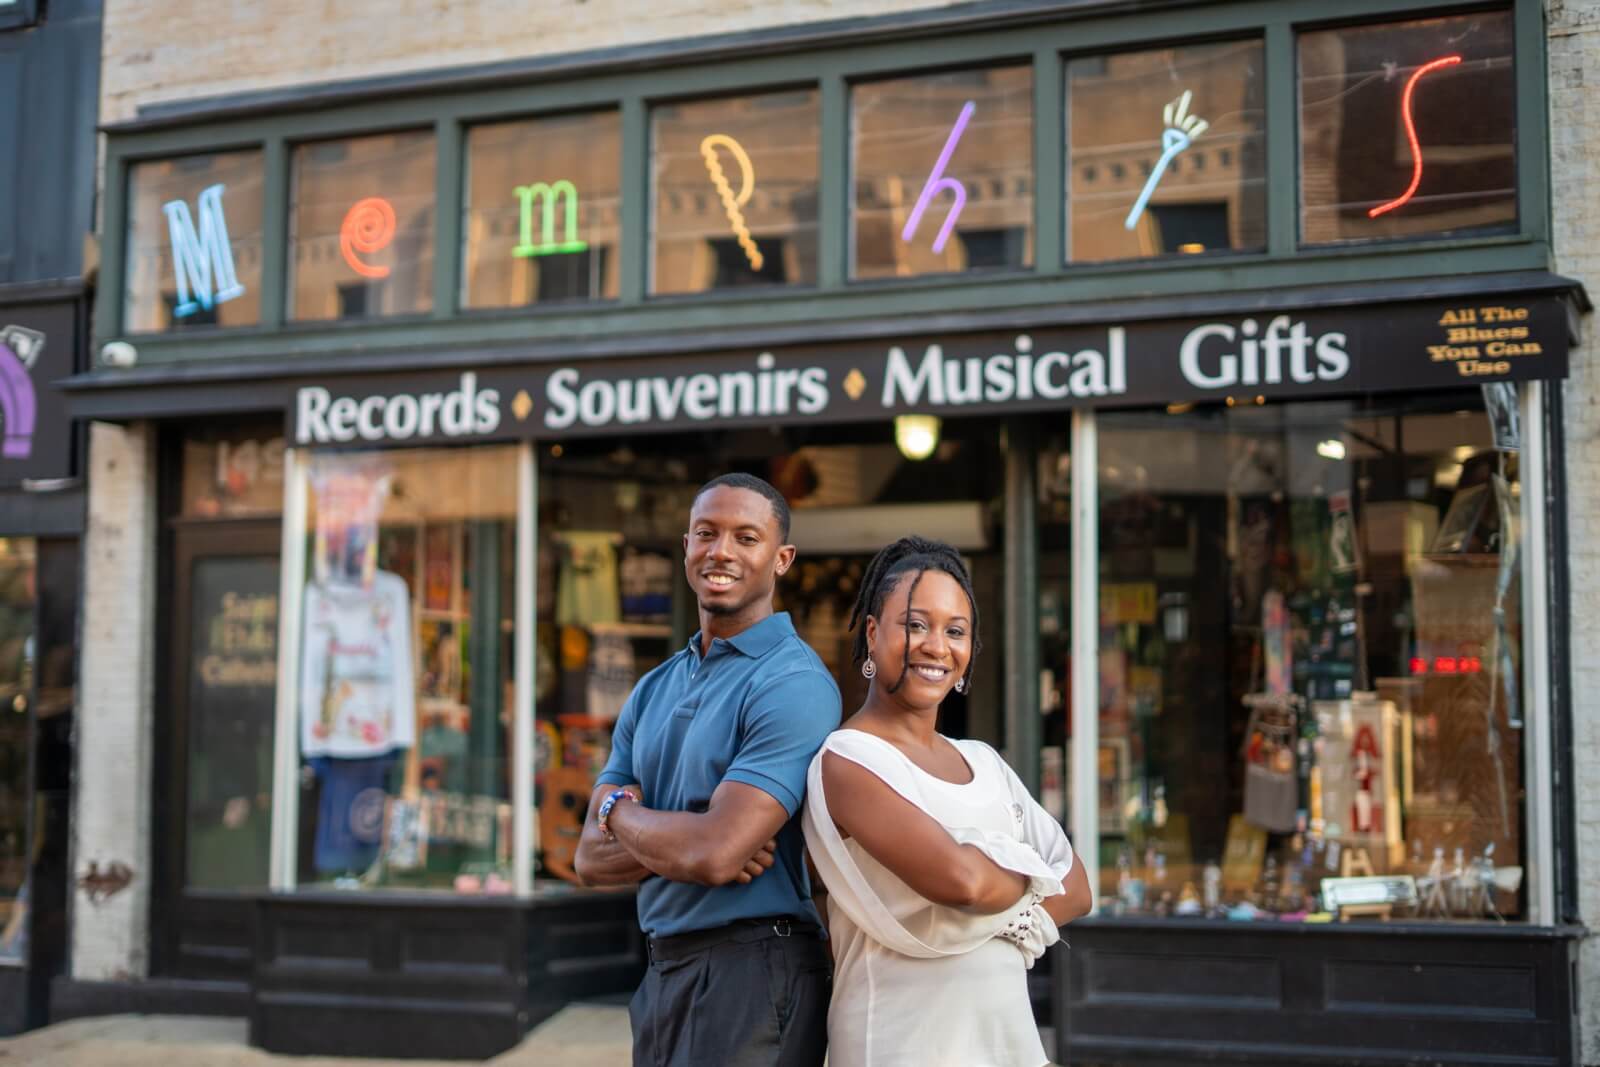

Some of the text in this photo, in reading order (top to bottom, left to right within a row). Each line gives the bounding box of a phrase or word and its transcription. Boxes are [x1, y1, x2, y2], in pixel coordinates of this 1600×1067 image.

[1438, 306, 1529, 326] All The
[1447, 326, 1529, 343] Blues
[1426, 341, 1542, 362] You Can
[1456, 360, 1511, 376] Use
[296, 316, 1351, 444] Records Souvenirs Musical Gifts
